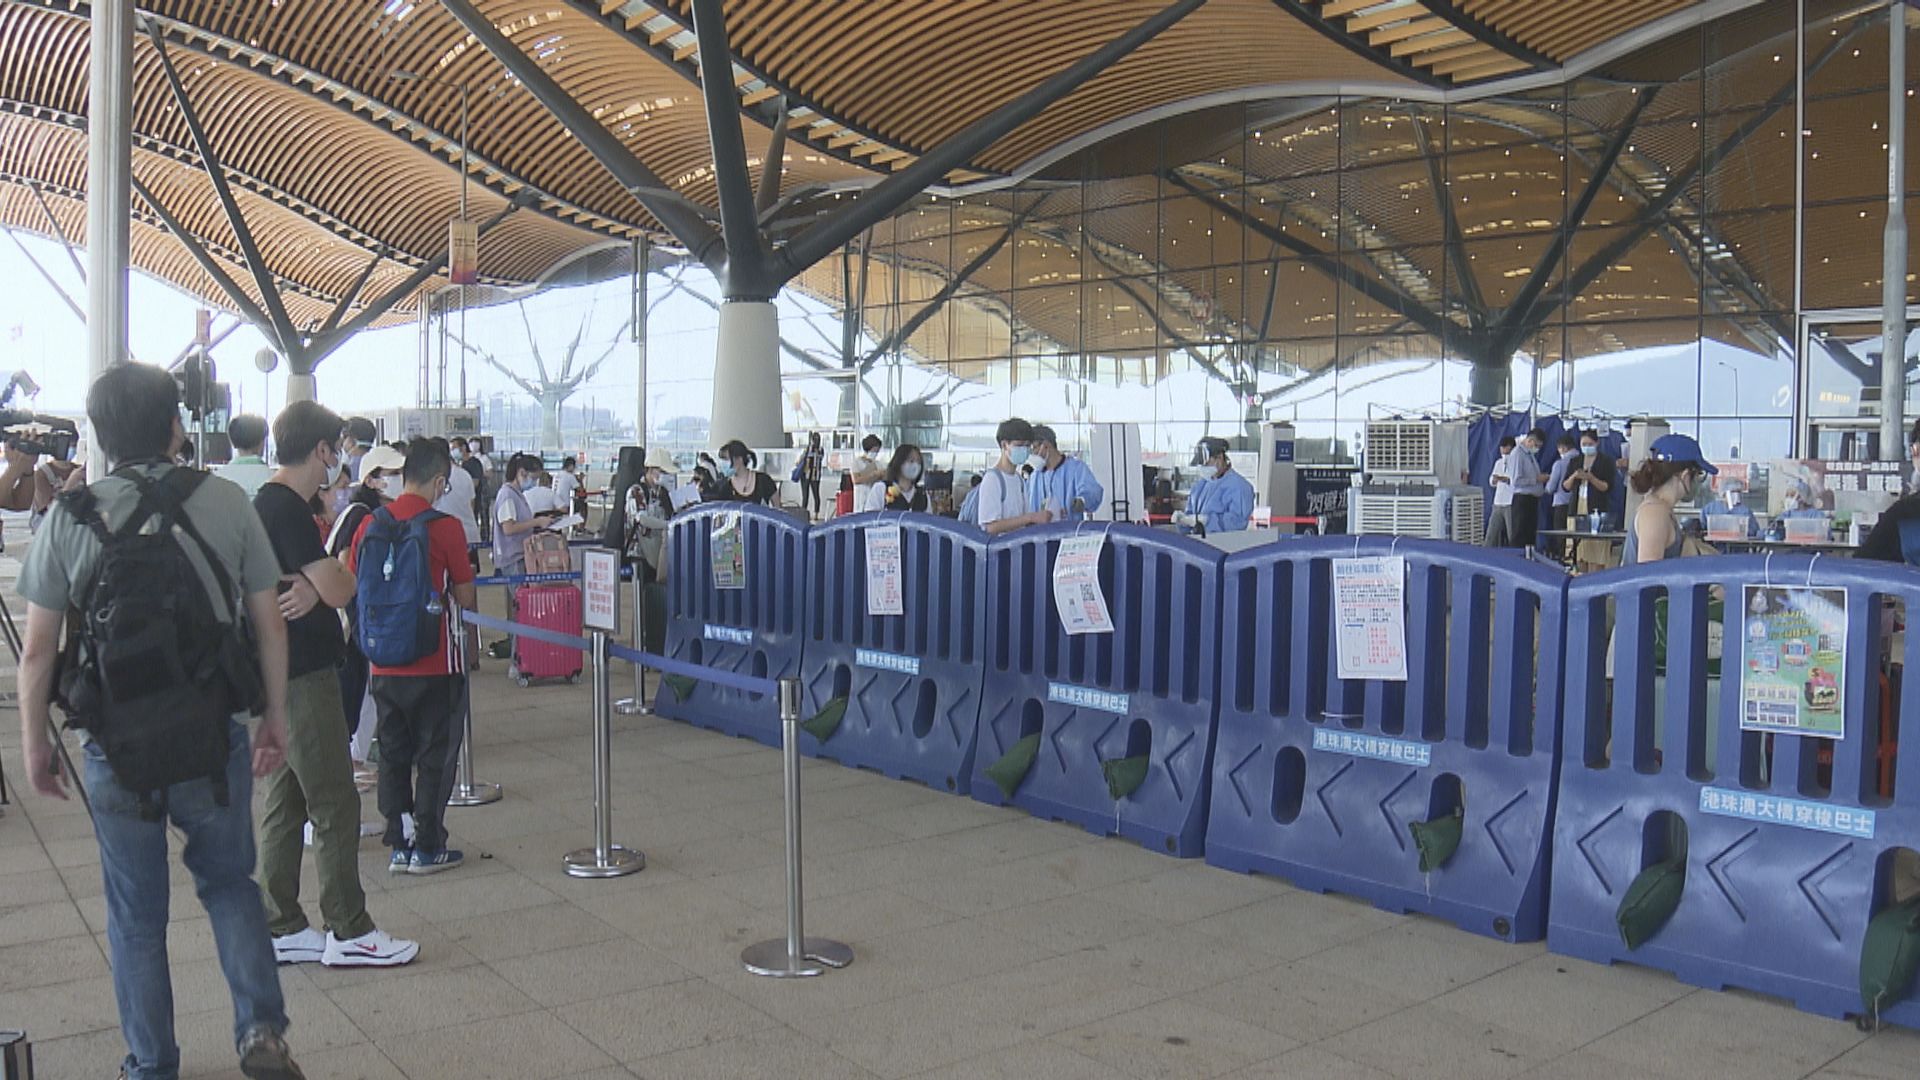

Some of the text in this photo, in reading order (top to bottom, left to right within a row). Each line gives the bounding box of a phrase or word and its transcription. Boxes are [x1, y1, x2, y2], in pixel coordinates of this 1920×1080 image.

[1315, 731, 1430, 762] 港珠澳大橋穿梭巴士
[1703, 789, 1873, 834] 港珠澳大橋穿梭巴士
